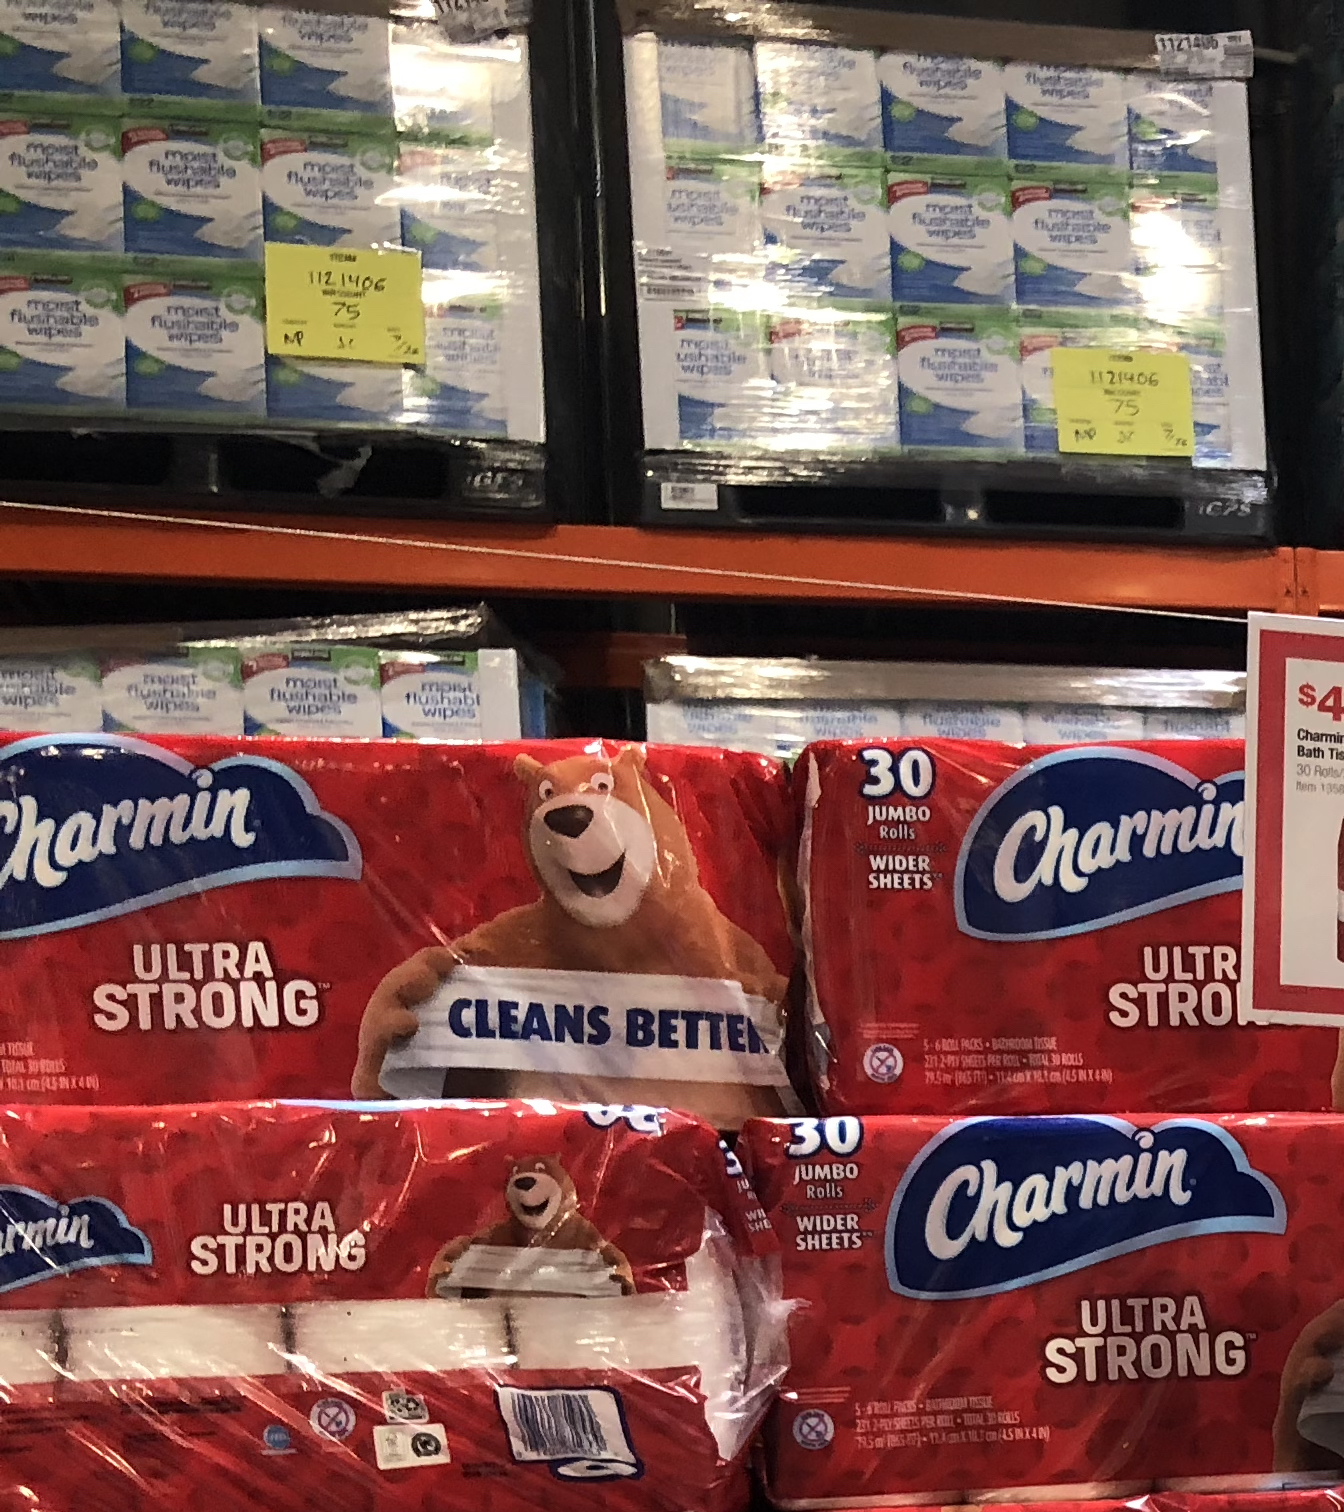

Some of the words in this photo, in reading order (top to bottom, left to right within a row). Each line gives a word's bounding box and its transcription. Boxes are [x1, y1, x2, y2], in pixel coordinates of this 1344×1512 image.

[165, 149, 217, 164] moist
[149, 161, 236, 179] flushable
[165, 176, 220, 191] wipes
[332, 301, 361, 320] 75
[1111, 399, 1140, 416] 75
[286, 676, 339, 691] moist
[269, 688, 357, 704] flushable
[286, 702, 341, 717] wipes
[1297, 745, 1325, 760] Bath
[863, 750, 933, 797] 30
[1297, 764, 1311, 777] 30
[868, 805, 930, 828] JUMBO
[878, 823, 917, 843] Rolls
[868, 854, 930, 876] WIDER
[134, 944, 274, 981] ULTRA
[93, 979, 320, 1030] STRONG
[449, 996, 610, 1050] CLEANS
[625, 1003, 770, 1058] BETTER
[927, 1129, 1193, 1262] Charmin
[1081, 1296, 1206, 1332] ULTRA
[1045, 1333, 1247, 1383] STRONG
